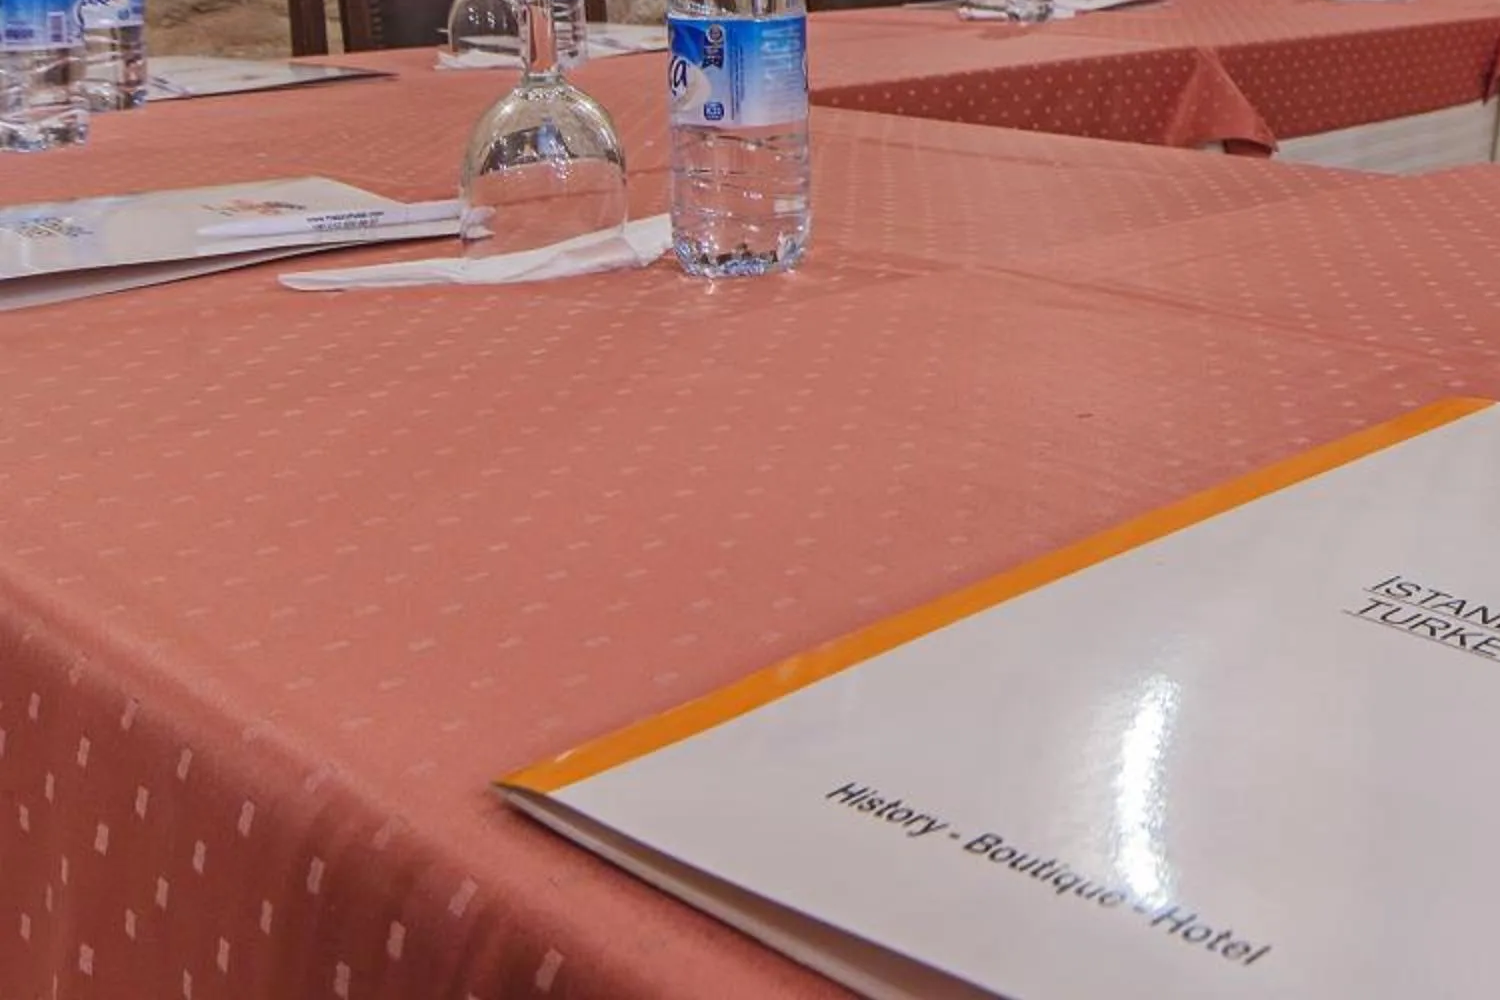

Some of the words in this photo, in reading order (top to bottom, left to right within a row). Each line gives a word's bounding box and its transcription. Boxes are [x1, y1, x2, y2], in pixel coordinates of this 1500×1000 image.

[825, 781, 948, 838] History
[963, 832, 1127, 907] Boutique
[1150, 905, 1272, 966] Hotel
